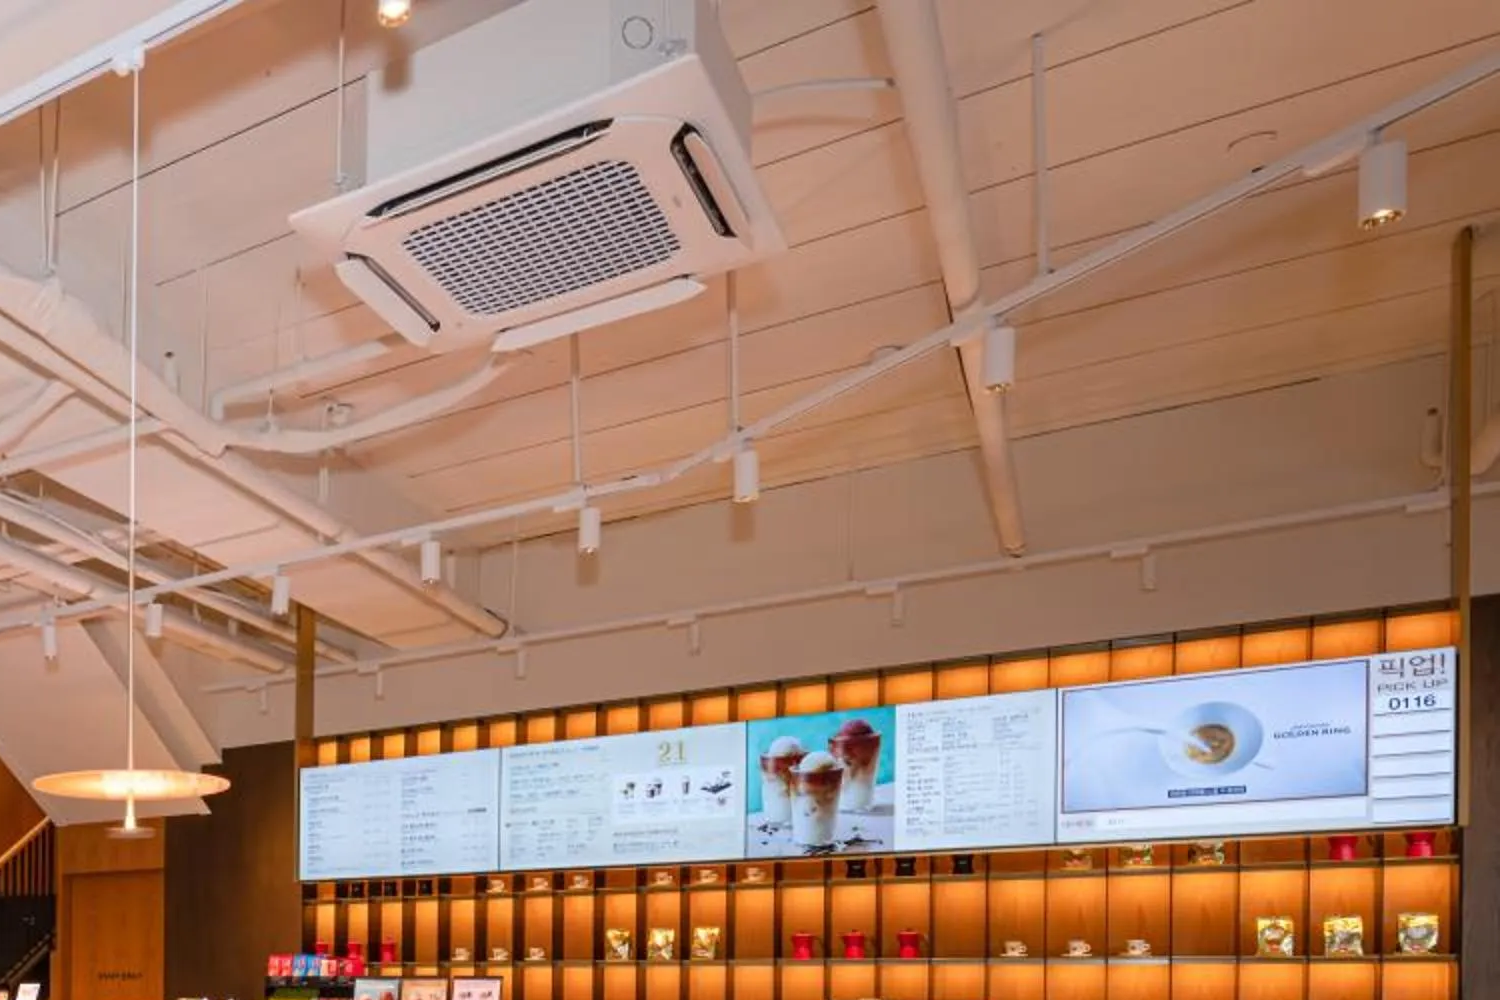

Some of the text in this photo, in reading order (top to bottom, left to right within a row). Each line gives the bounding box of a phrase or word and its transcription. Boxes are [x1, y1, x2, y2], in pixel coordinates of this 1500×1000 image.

[1379, 652, 1445, 678] 픽업!
[1376, 677, 1448, 693] PICK UP
[1388, 693, 1437, 710] 0116
[657, 740, 687, 765] 21
